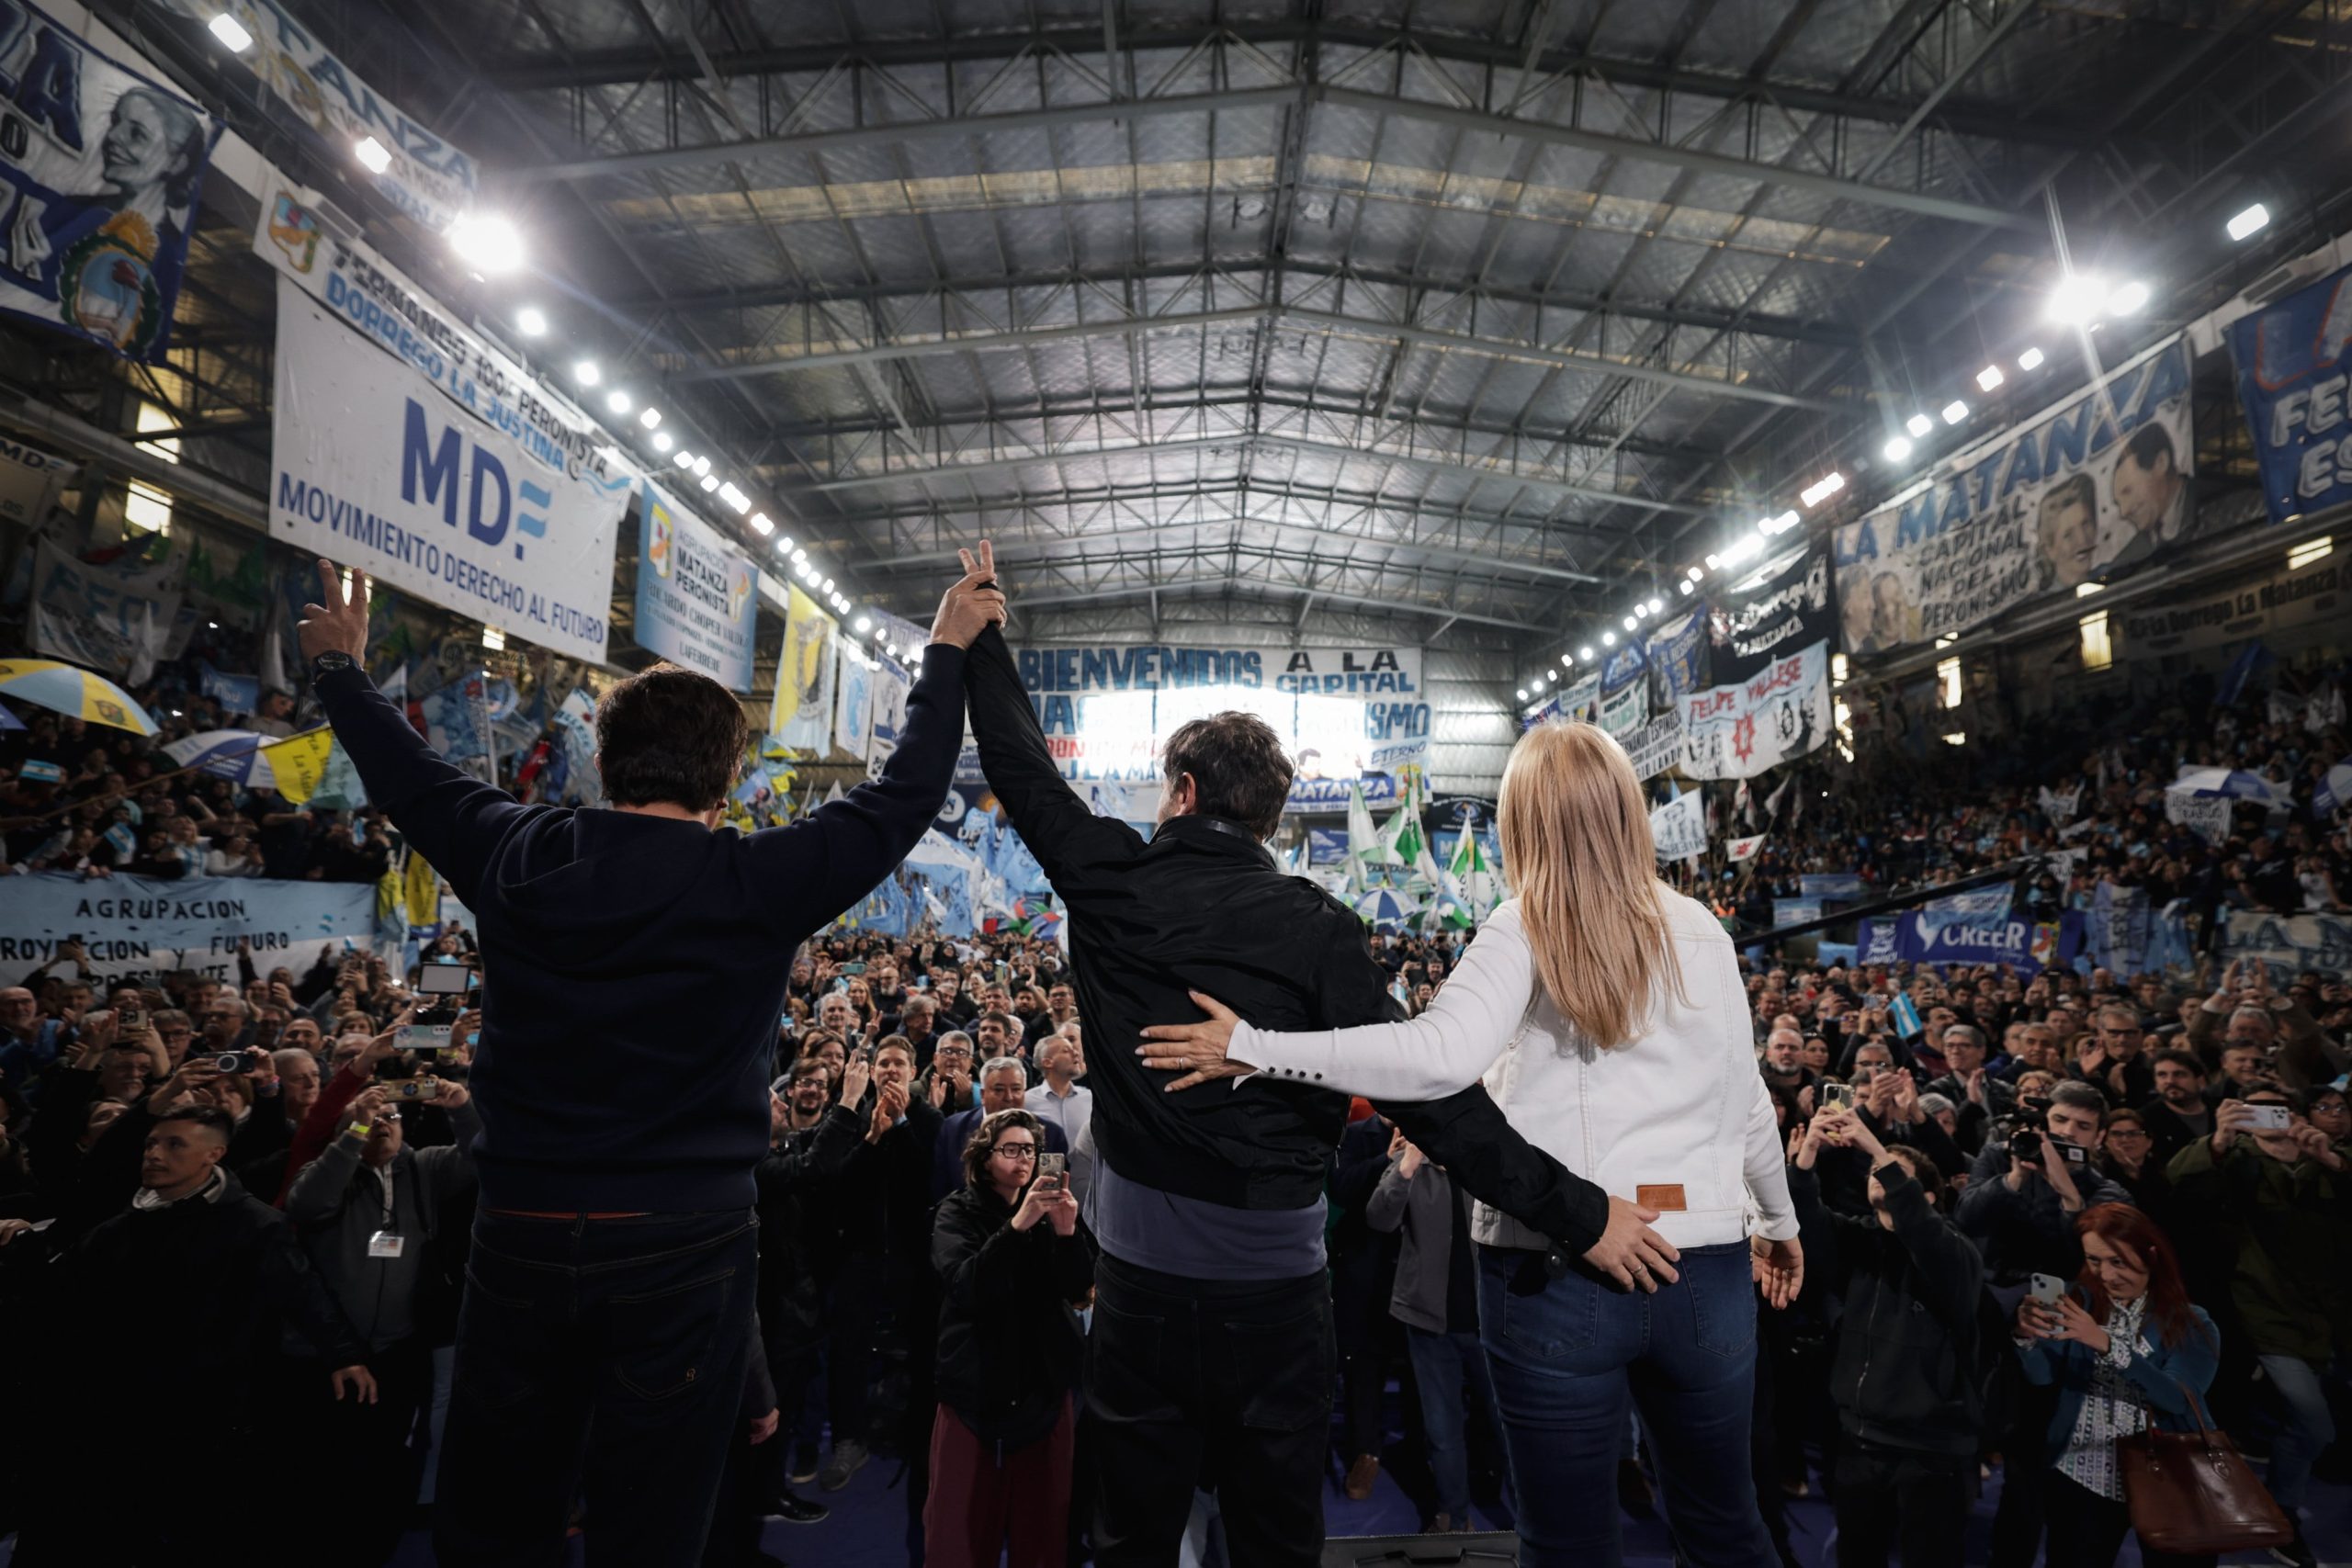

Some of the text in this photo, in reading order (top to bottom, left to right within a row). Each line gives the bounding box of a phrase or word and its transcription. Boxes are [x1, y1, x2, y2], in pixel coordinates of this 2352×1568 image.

[243, 0, 478, 191] TANZA
[325, 271, 564, 472] DORREGO LA JUSTINA
[2271, 373, 2352, 447] FE
[519, 391, 608, 479] PERONISTA
[1837, 342, 2190, 569] LA MATANZA
[1918, 494, 2029, 566] CAPITAL
[277, 470, 605, 645] MOVIMIENTO DERECHO AL FUTURO
[676, 548, 729, 594] MATANZA
[1919, 528, 2030, 592] NACIONAL
[675, 570, 729, 617] PERONISTA
[1921, 559, 2030, 631] PERONISMO
[1951, 564, 1992, 599] DEL
[2259, 567, 2337, 609] Matanza
[1018, 646, 1400, 692] BIENVENIDOS A LA
[1275, 671, 1416, 694] CAPITAL
[1690, 691, 1736, 721] FELIPE
[1371, 740, 1427, 765] ETERNO
[76, 899, 246, 920] AGRUPACION
[210, 931, 289, 956] FUURO
